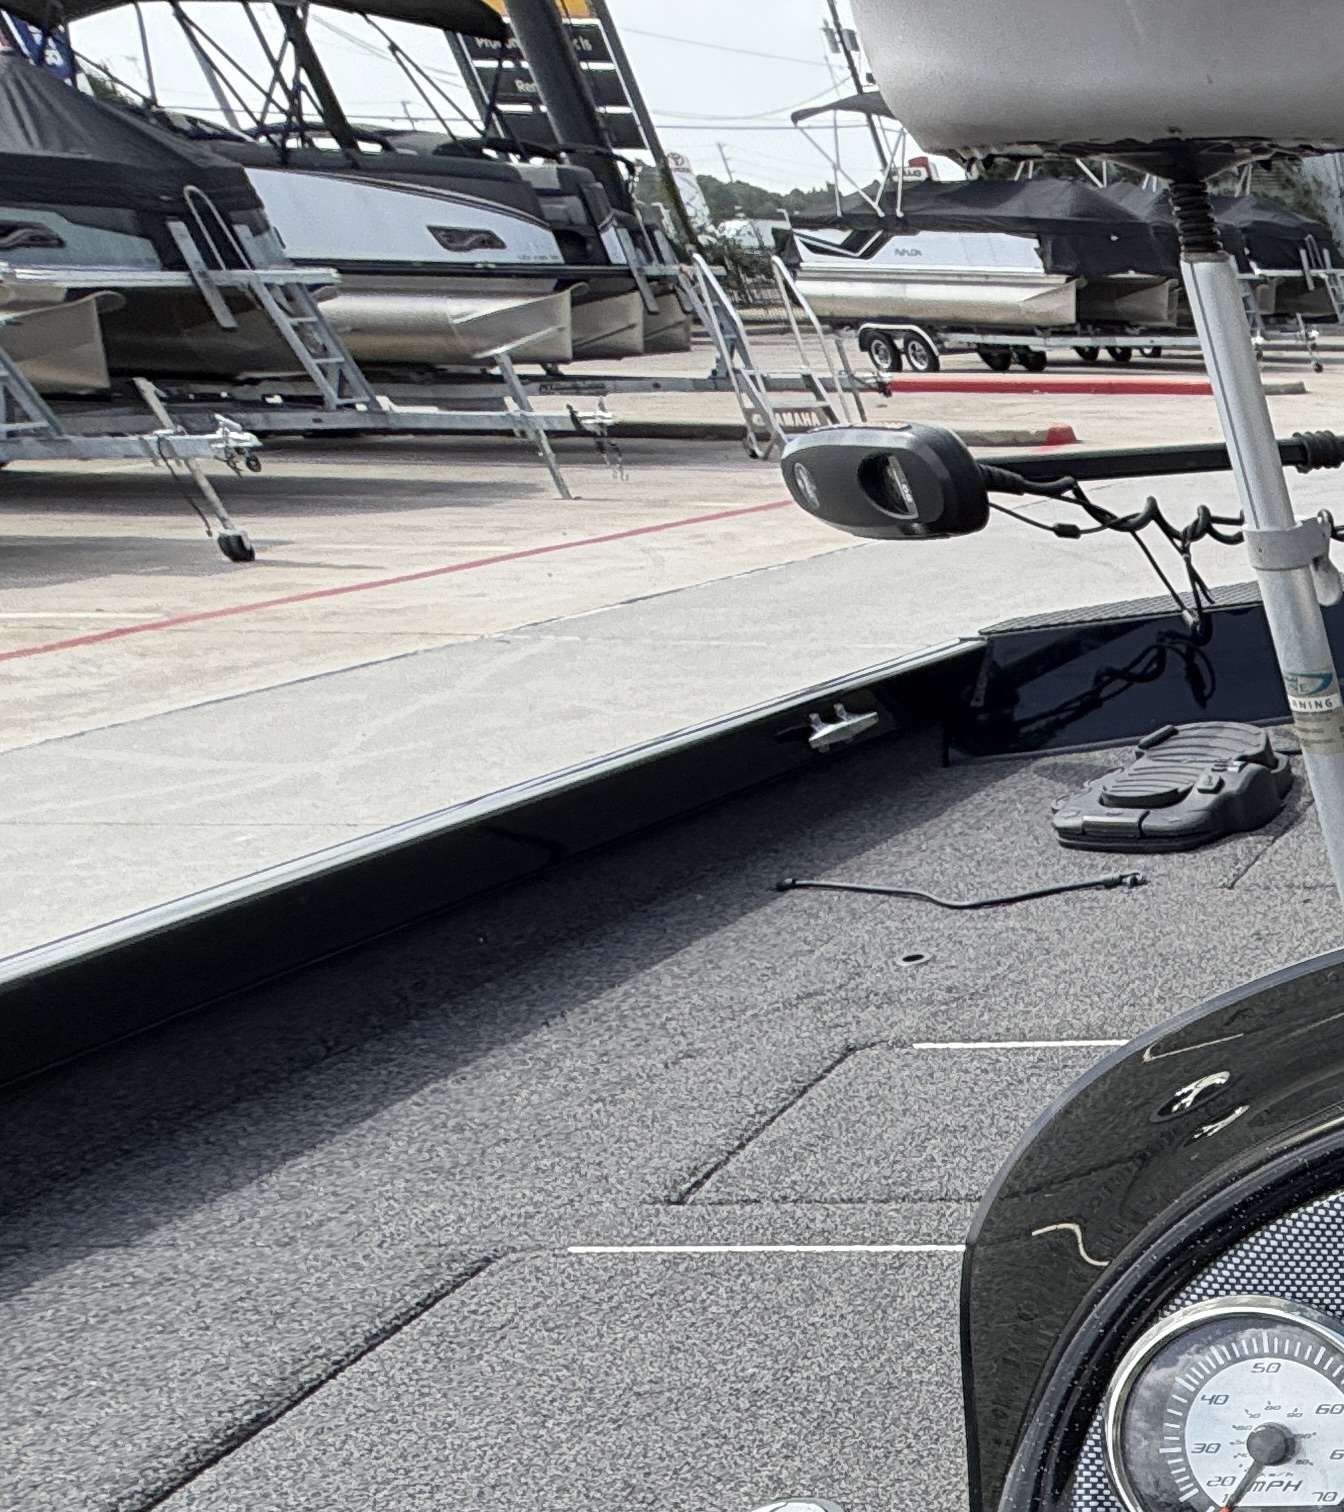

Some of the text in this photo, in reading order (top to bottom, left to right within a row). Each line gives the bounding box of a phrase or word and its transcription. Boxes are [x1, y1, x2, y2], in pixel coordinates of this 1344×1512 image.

[774, 411, 821, 427] AMAHA
[1251, 1361, 1283, 1374] 50
[1200, 1394, 1230, 1406] 40
[1190, 1442, 1222, 1454] 30
[1206, 1475, 1237, 1487] 20
[1249, 1479, 1303, 1492] MPH
[1312, 1491, 1338, 1503] 70
